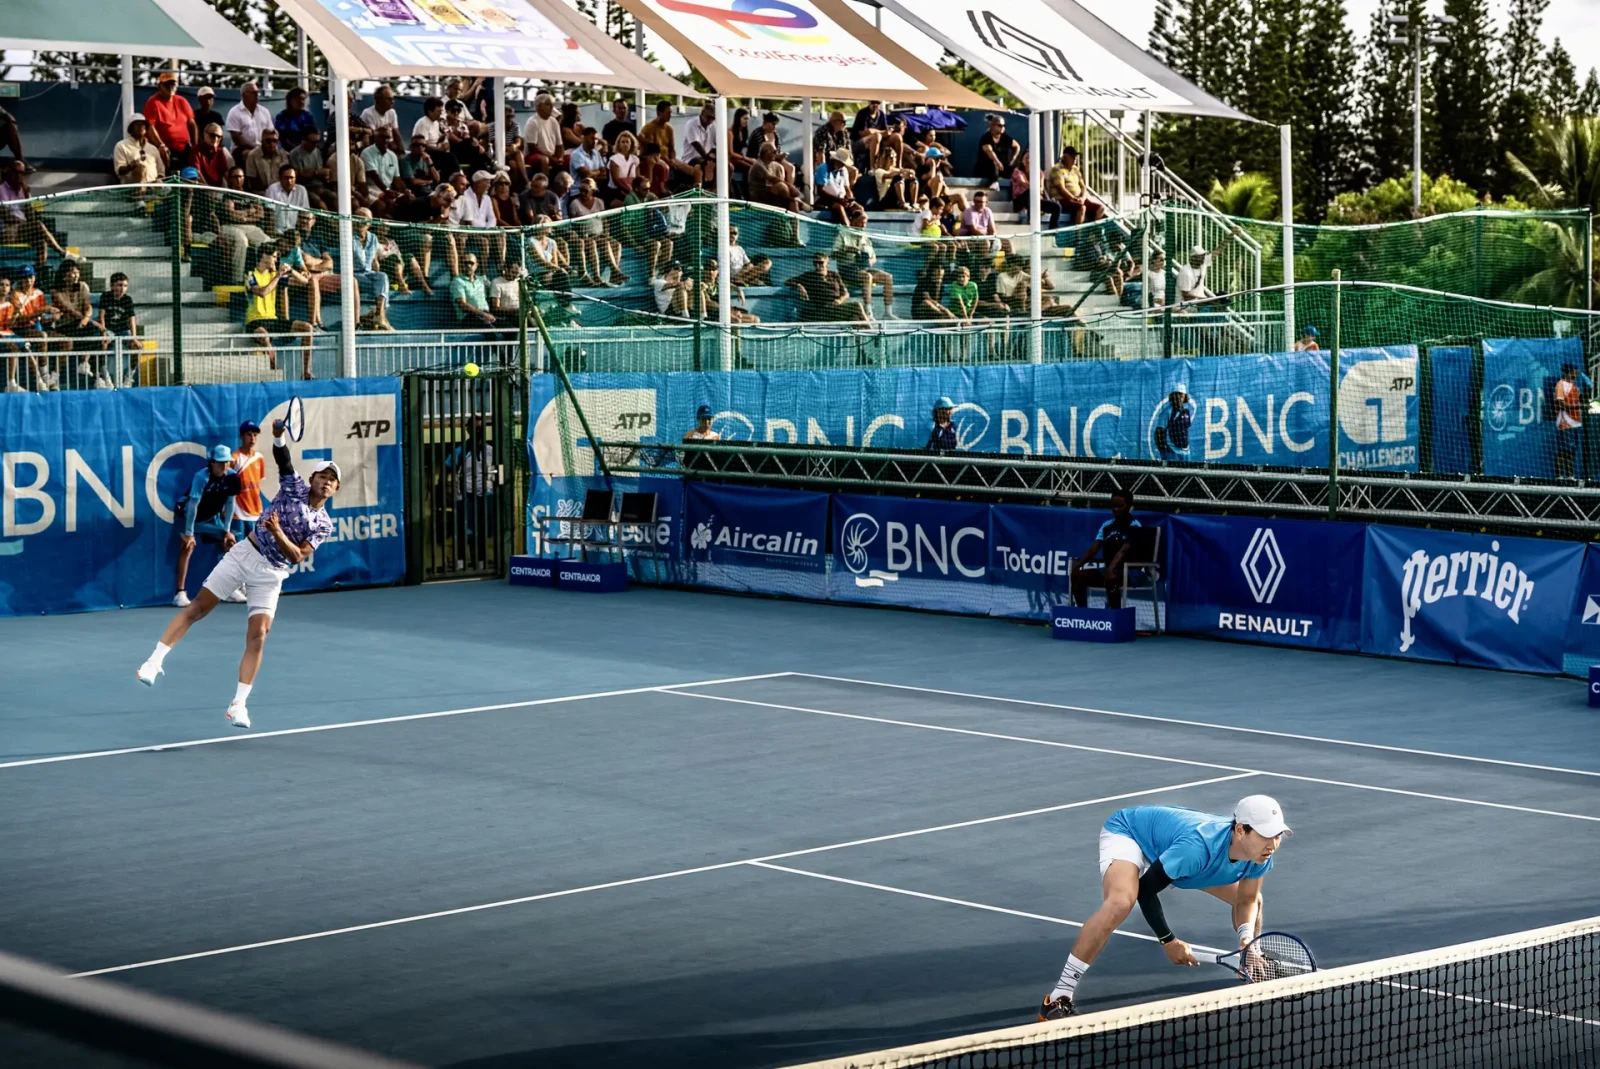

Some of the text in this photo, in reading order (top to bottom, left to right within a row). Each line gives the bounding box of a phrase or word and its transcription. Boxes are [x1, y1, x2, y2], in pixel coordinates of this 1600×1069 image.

[361, 35, 600, 73] NESCAF
[711, 44, 877, 67] TotalEnergies
[1030, 81, 1158, 99] RENAULT
[1389, 377, 1414, 391] ATP
[346, 419, 391, 440] ATP
[613, 412, 652, 430] ATP
[1204, 391, 1315, 460] BNC
[1336, 446, 1416, 470] CHALLENGER
[2, 441, 208, 538] BNC
[325, 513, 398, 542] ENGER
[714, 526, 819, 555] Aircalin
[886, 521, 986, 578] BNC
[511, 566, 551, 577] CENTRAKOR
[996, 546, 1071, 576] TotalE
[560, 571, 601, 582] CENTRAKOR
[1054, 617, 1112, 632] CENTRAKOR
[1218, 612, 1313, 637] RENAULT
